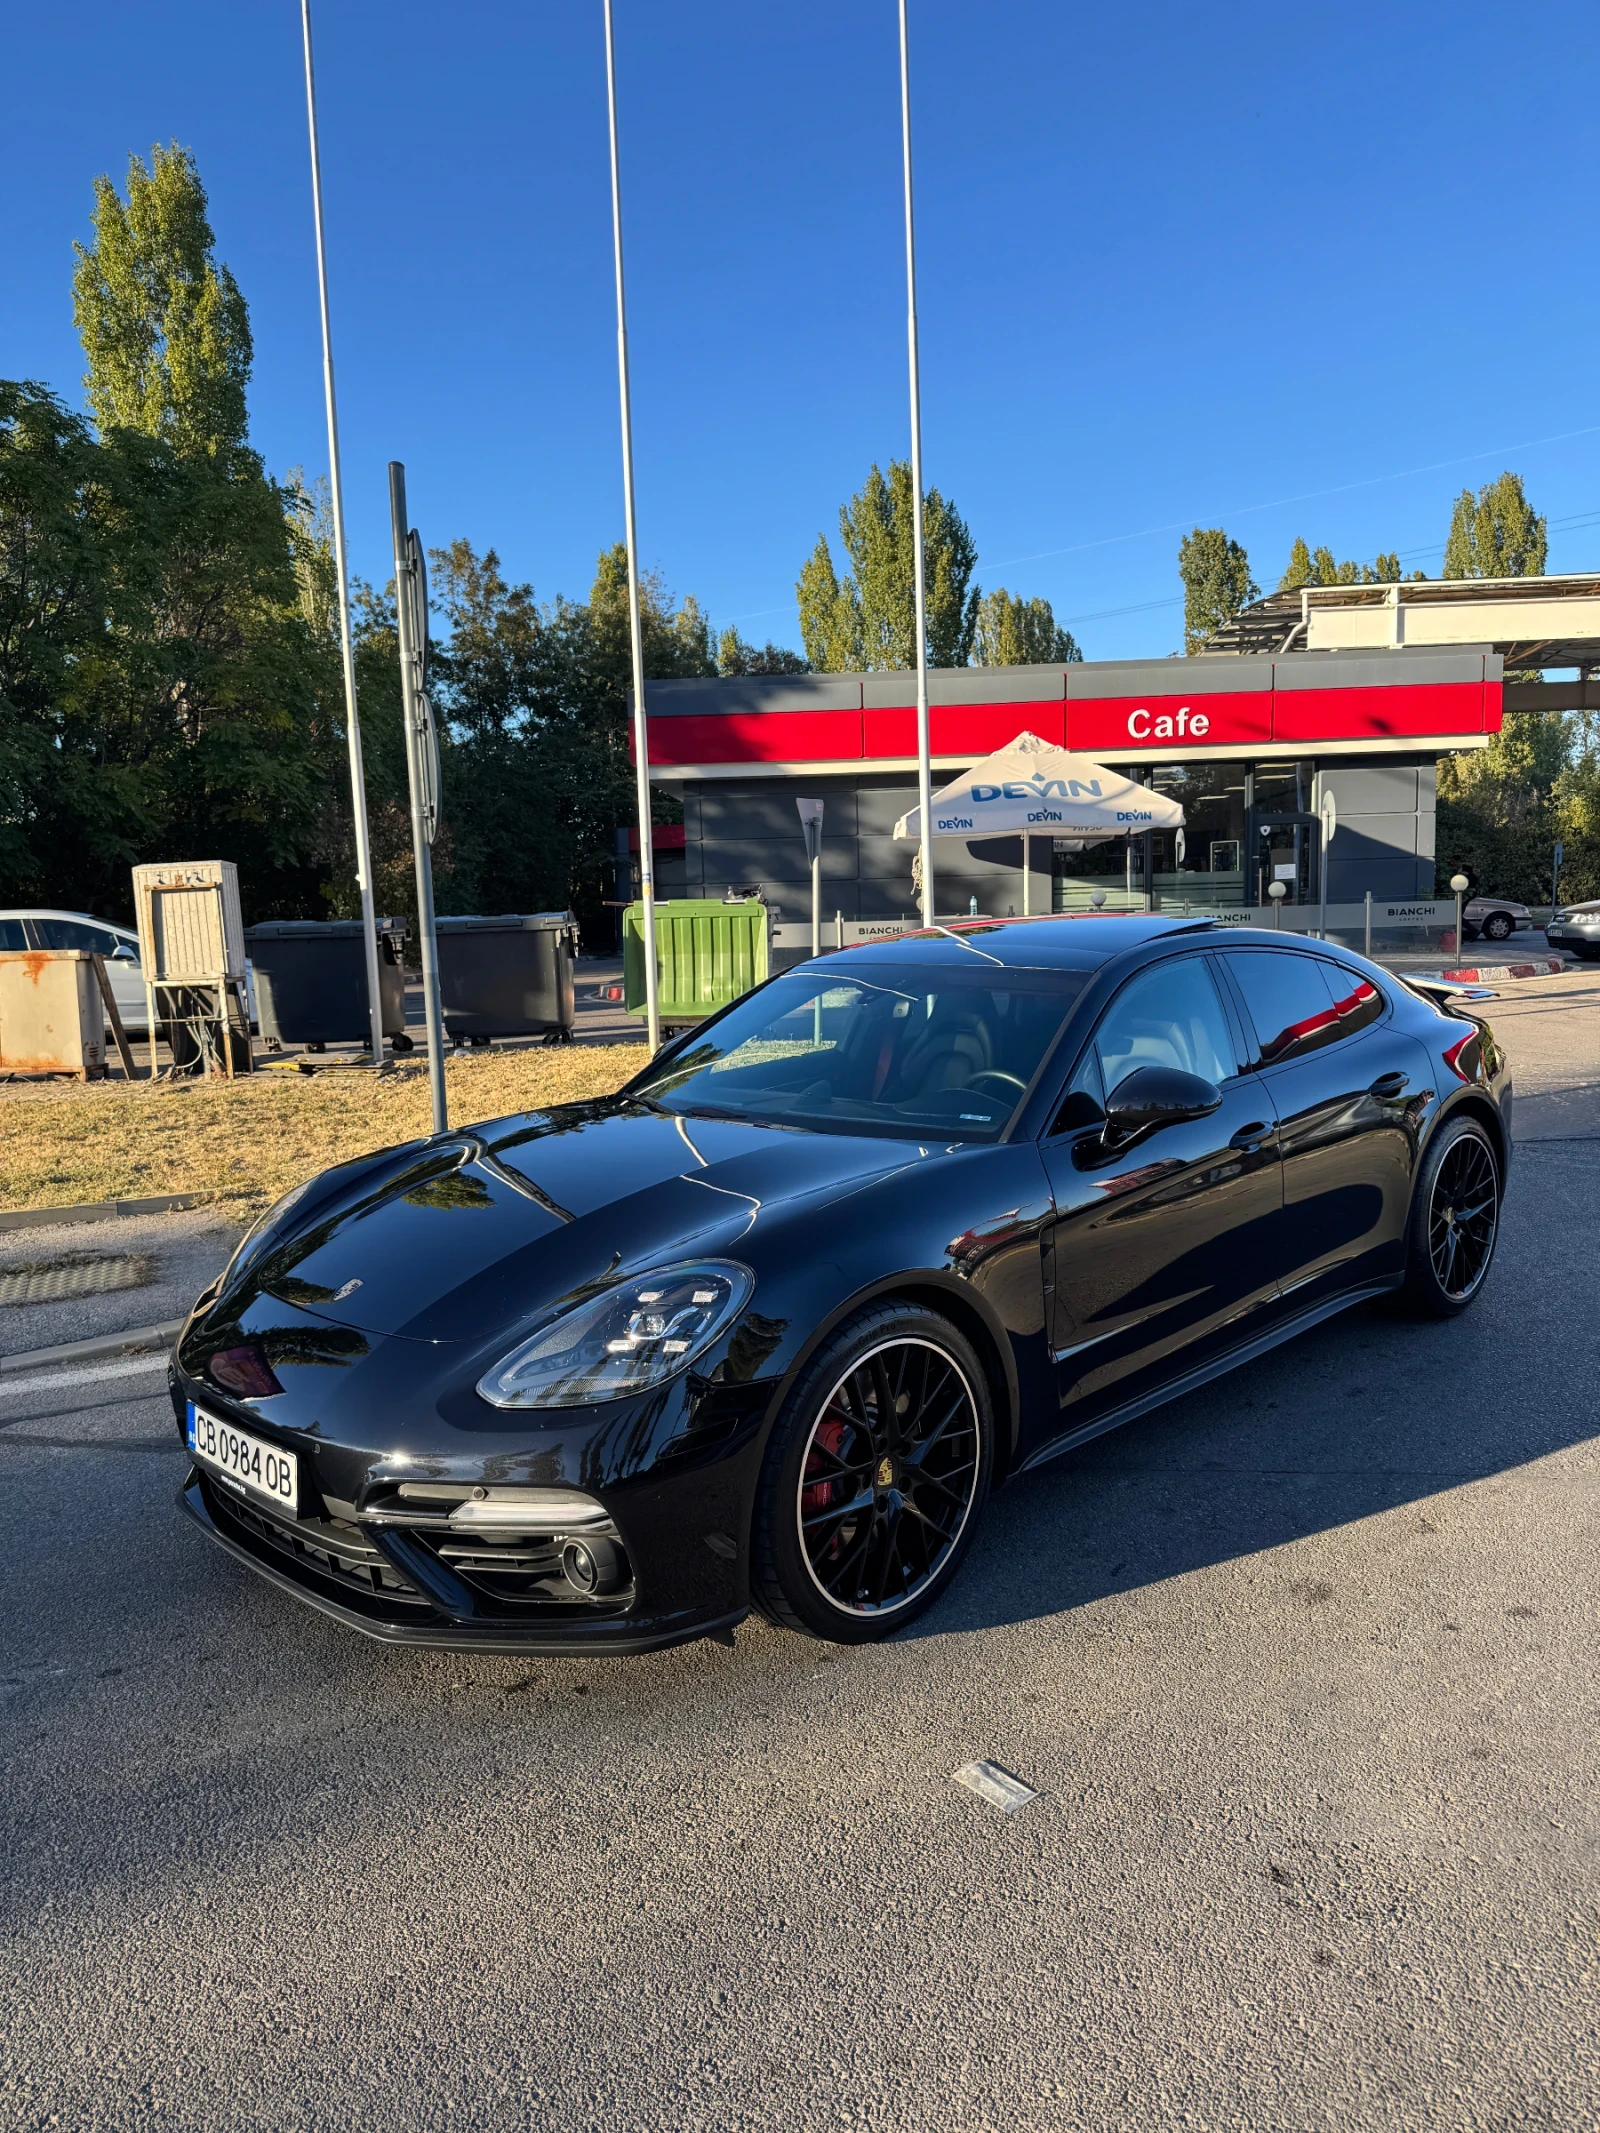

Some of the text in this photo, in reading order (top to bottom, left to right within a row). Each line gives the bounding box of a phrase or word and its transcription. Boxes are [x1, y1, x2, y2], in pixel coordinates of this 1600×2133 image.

[1127, 707, 1210, 739] Cafe
[971, 777, 1102, 802] DEVIN
[1027, 811, 1062, 822] DEVIN
[1117, 810, 1152, 822] DEVIN
[938, 817, 973, 829] DEVIN
[1388, 907, 1435, 916] BIANCHI
[858, 927, 903, 935] BIANCHI
[879, 1322, 897, 1334] Pro
[197, 1415, 292, 1498] CB 0984 OB
